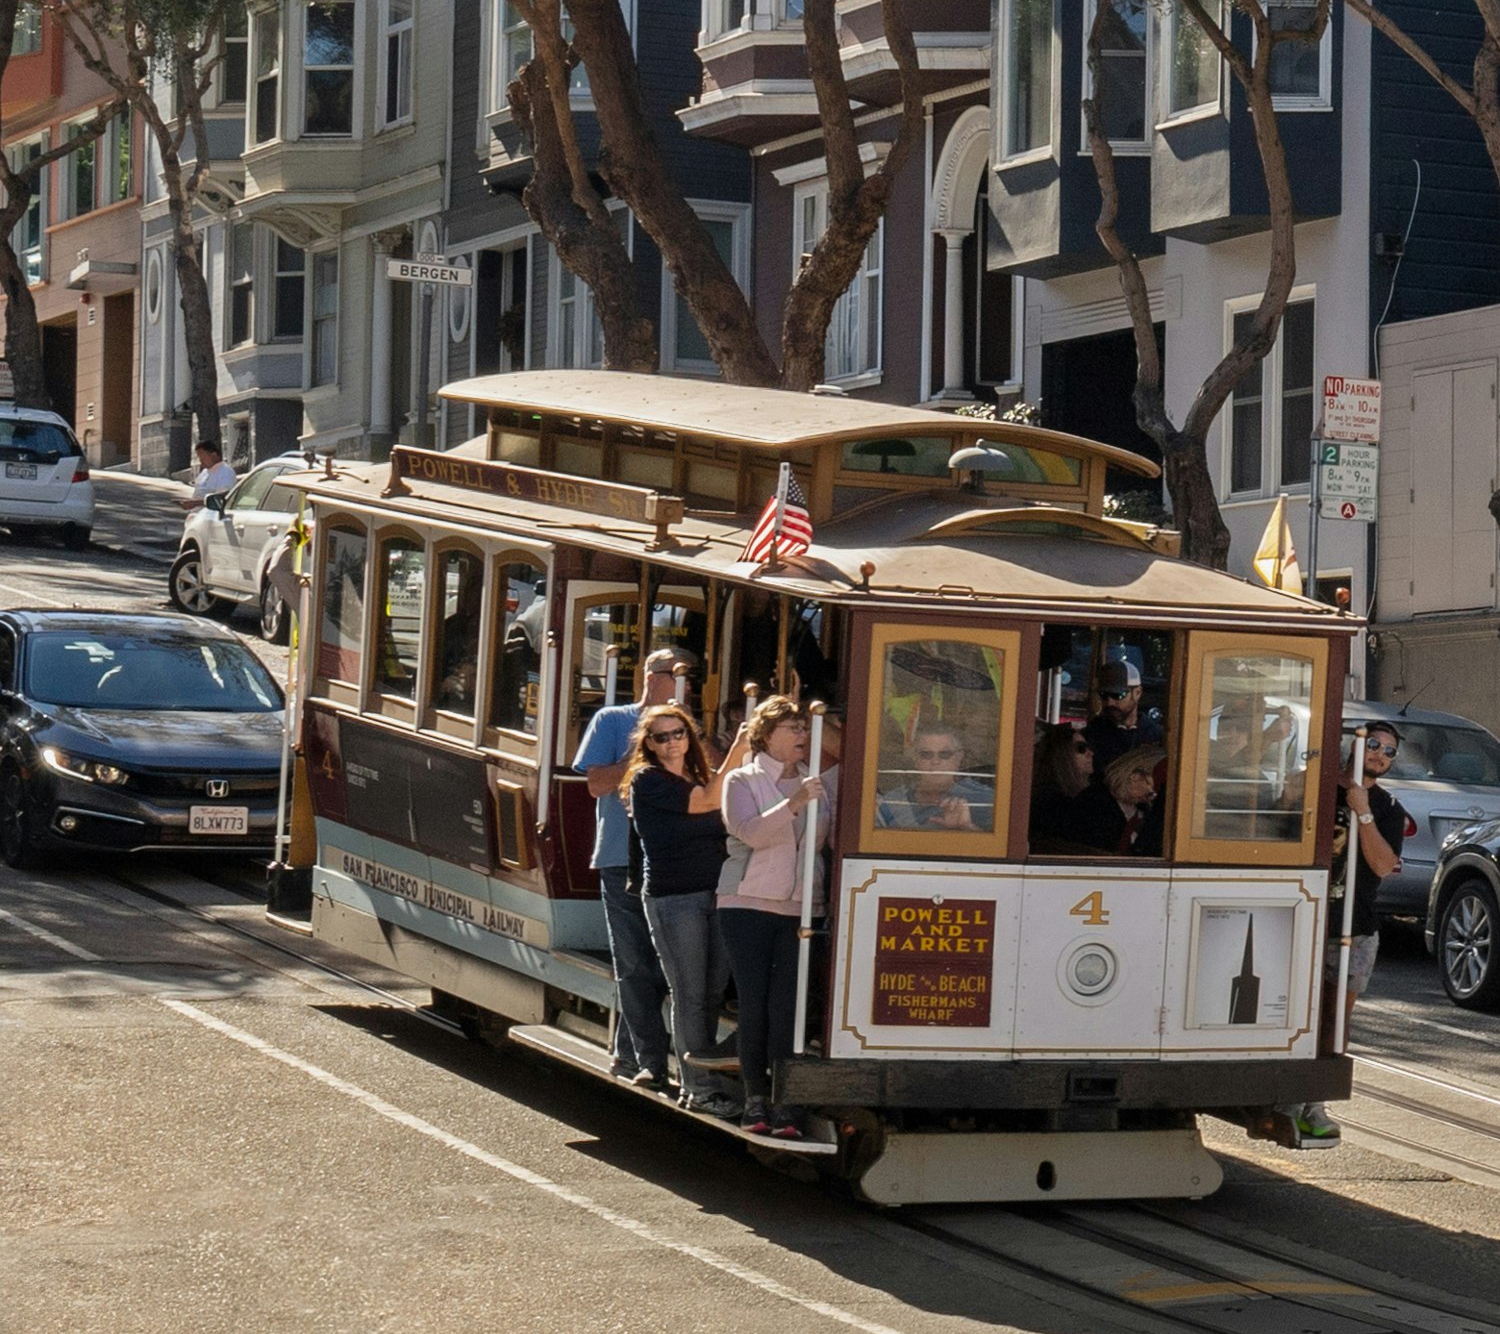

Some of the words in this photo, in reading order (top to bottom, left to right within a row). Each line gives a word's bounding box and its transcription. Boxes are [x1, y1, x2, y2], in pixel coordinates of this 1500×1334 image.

[400, 264, 459, 281] BERGEN
[1326, 378, 1342, 395] NO
[1345, 383, 1379, 398] PARKING
[1326, 446, 1337, 463] 2
[1347, 450, 1370, 459] HOUR
[1341, 459, 1376, 470] PARKING
[408, 454, 492, 490] POWELL
[506, 473, 522, 496] &
[536, 477, 594, 507] HYDE
[1327, 483, 1342, 492] MON
[1358, 486, 1371, 494] SAT
[1343, 504, 1353, 516] A
[322, 750, 334, 780] 4
[194, 816, 243, 830] 8LXW773
[343, 854, 362, 877] SAN
[365, 863, 419, 898] FRANCISCO
[884, 908, 988, 925] POWELL
[1069, 891, 1110, 925] 4
[911, 925, 963, 937] AND
[880, 936, 989, 953] MARKET
[880, 973, 916, 991] HYDE
[939, 974, 986, 992] BEACH
[888, 994, 977, 1008] FISHERMANS
[908, 1008, 955, 1021] WHARF
